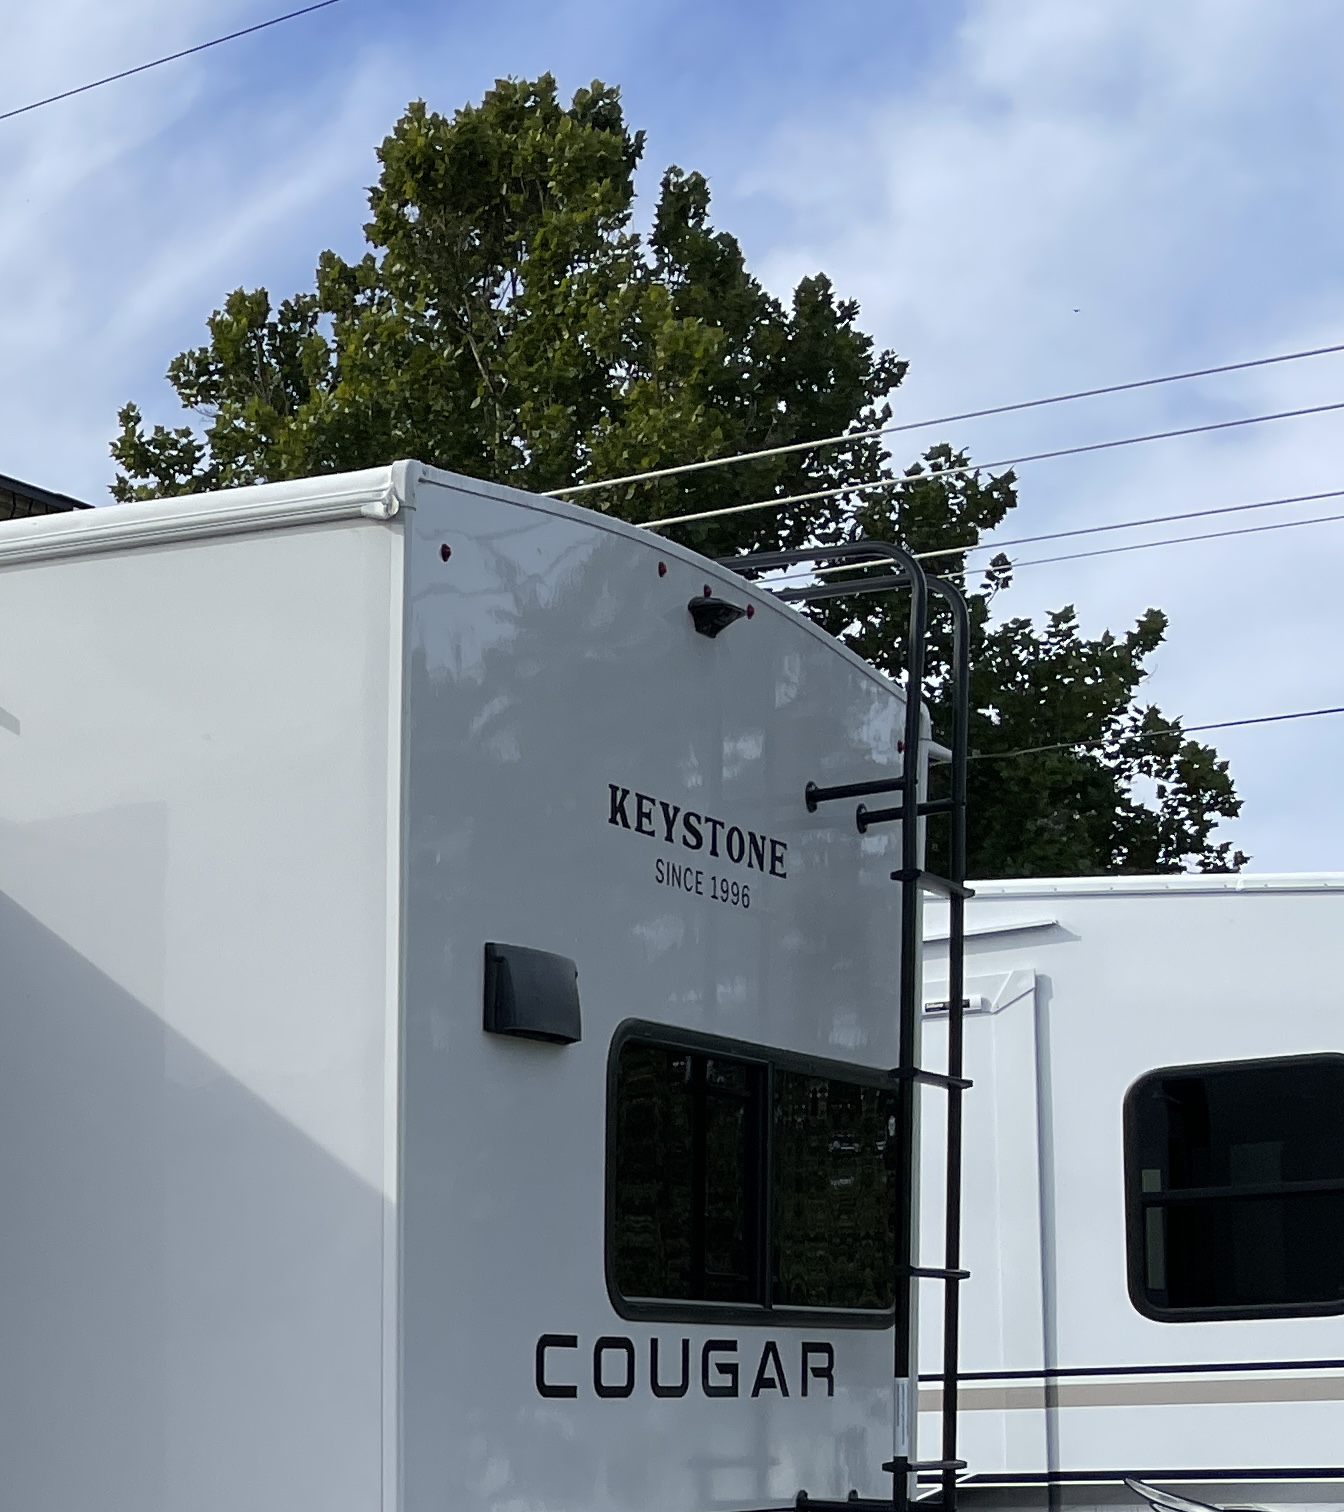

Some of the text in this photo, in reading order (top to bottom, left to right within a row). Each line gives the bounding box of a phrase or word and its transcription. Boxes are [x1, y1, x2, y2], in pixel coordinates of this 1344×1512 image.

[608, 783, 787, 879] KEYSTONE
[655, 858, 750, 908] SINCE 1996
[536, 1334, 834, 1398] COUGAR
